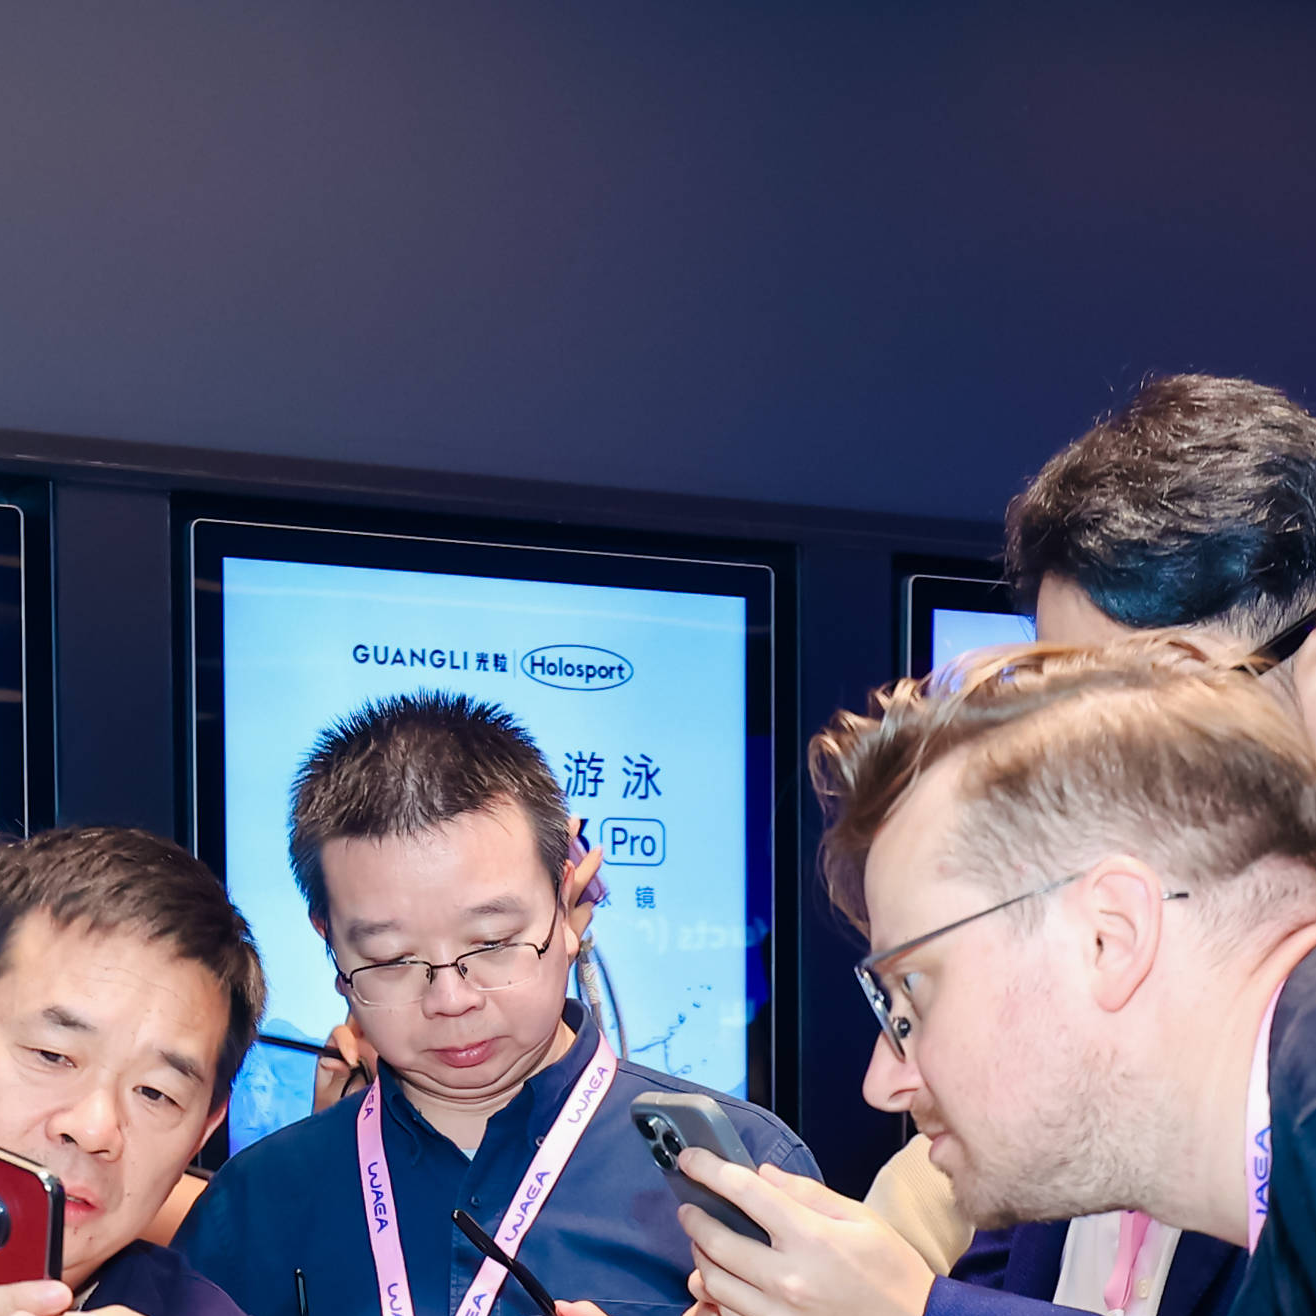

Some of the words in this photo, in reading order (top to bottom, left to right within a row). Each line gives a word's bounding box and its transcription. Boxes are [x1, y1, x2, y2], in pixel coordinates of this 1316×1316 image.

[352, 644, 468, 671] GUANGLI
[475, 652, 508, 673] 光粒
[530, 655, 626, 684] Holosport
[563, 750, 663, 800] 游泳
[611, 826, 658, 858] Pro
[568, 1065, 609, 1124] WAEA
[367, 1161, 390, 1234] WAEA
[1255, 1125, 1273, 1214] AEA
[504, 1170, 551, 1242] WAEA
